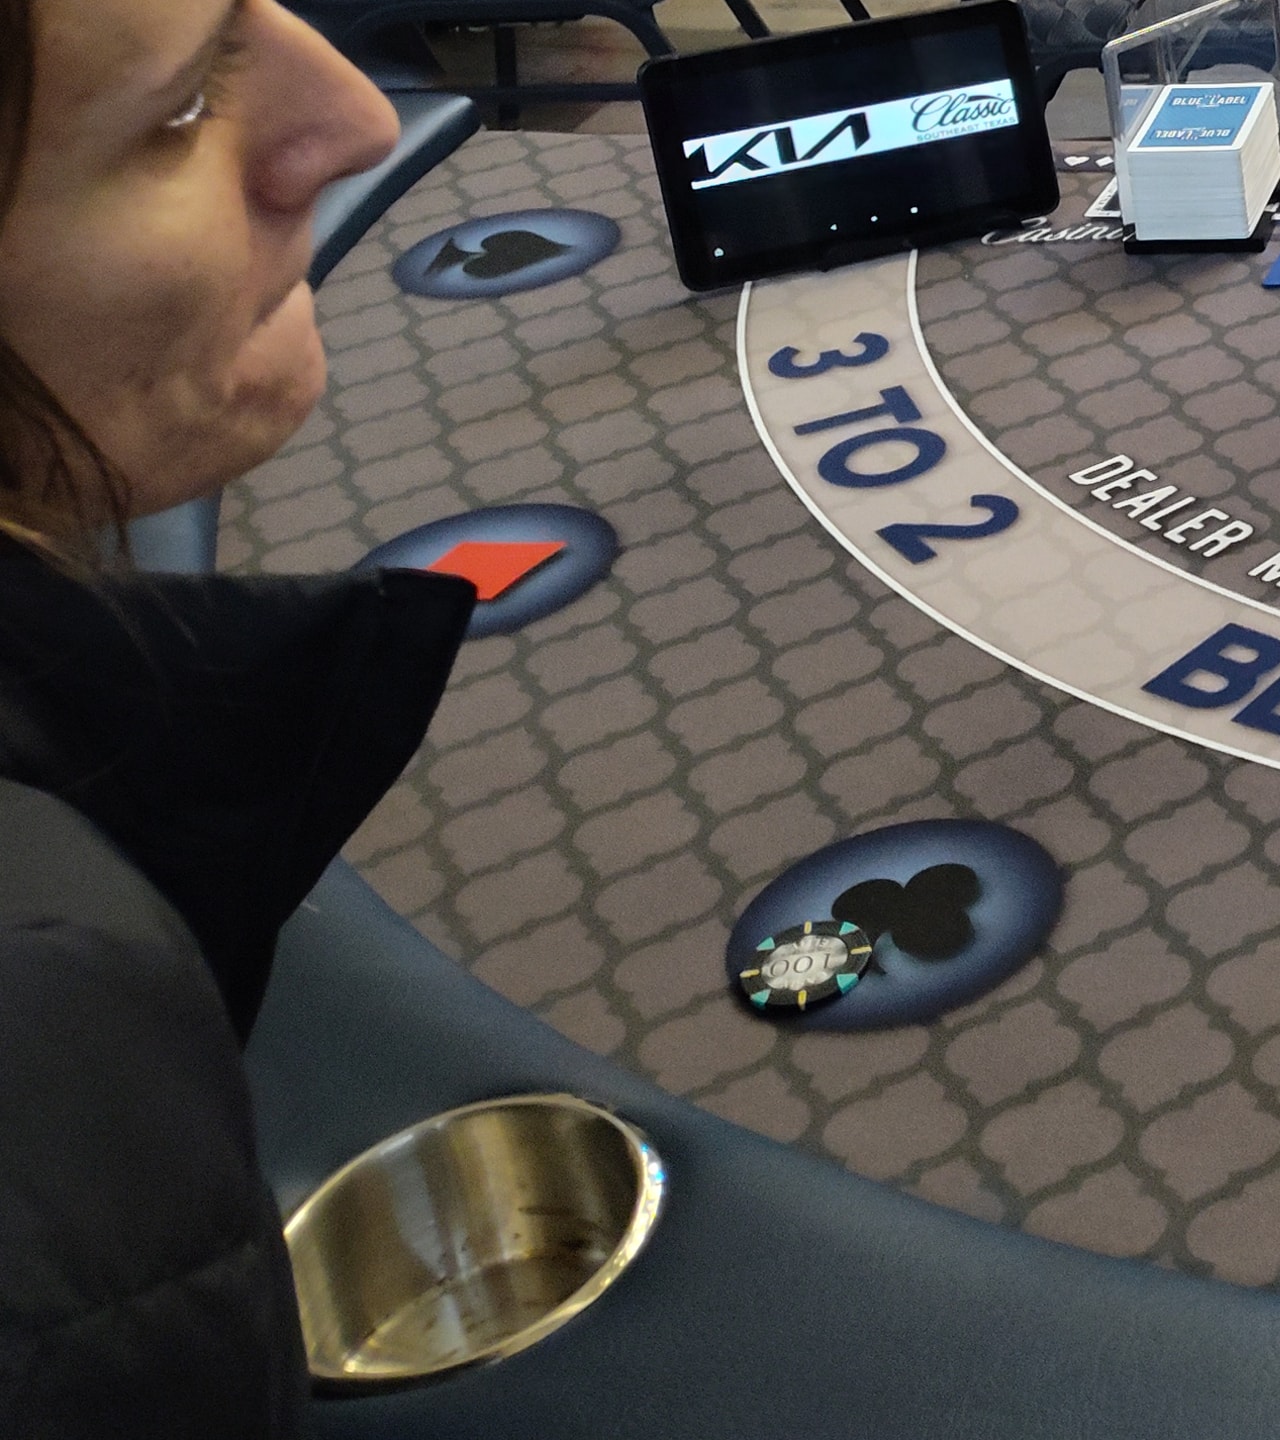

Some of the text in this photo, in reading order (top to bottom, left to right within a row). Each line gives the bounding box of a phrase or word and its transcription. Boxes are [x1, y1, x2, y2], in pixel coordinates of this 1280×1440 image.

[910, 93, 1015, 133] Classic
[1171, 97, 1204, 106] BLUE
[1207, 95, 1247, 105] LABEL
[916, 116, 1017, 142] SOUTHEAST TEXAS
[768, 331, 1020, 566] 3 TO 2
[1068, 454, 1255, 558] DEALER
[769, 953, 831, 978] 100
